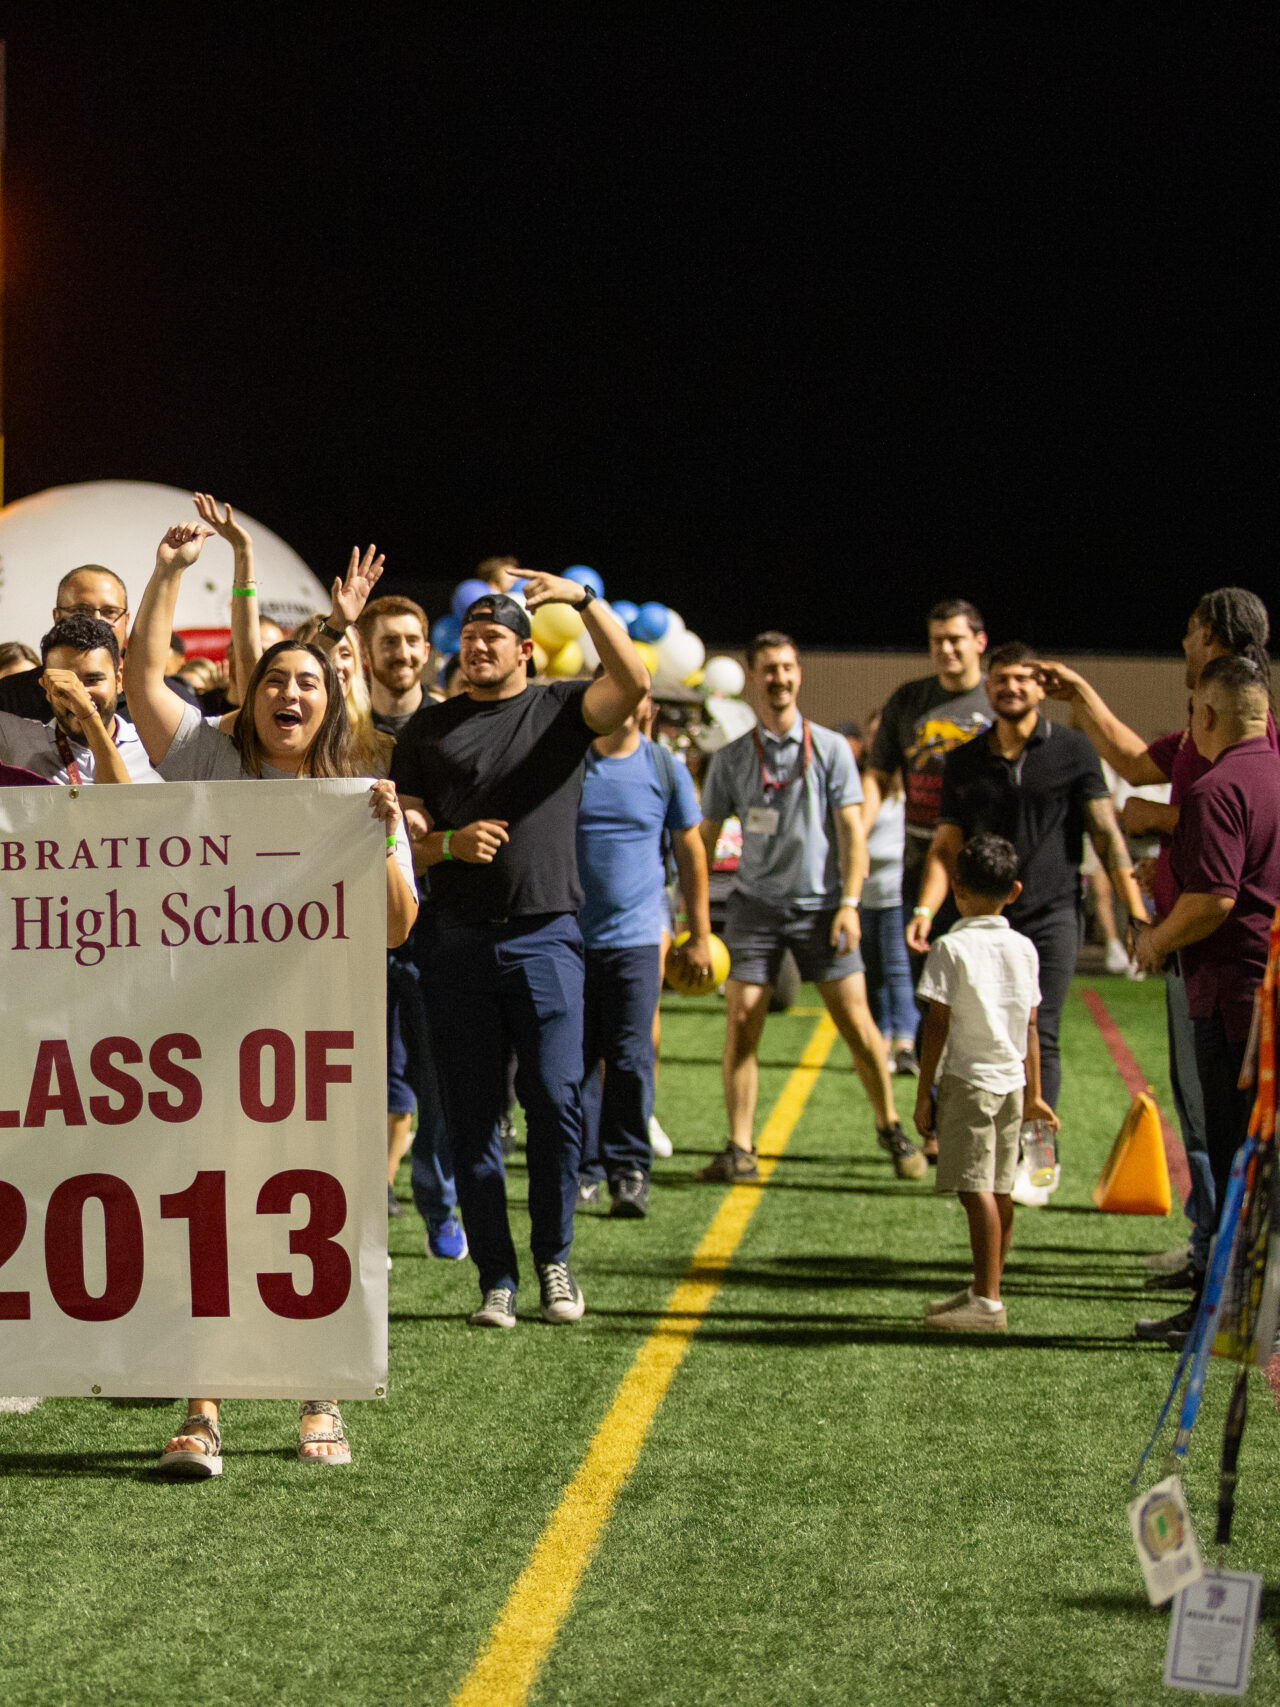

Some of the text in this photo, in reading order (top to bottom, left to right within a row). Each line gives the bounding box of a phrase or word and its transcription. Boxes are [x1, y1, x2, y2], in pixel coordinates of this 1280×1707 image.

[13, 888, 141, 967] High
[161, 880, 351, 947] School
[239, 1028, 355, 1124] OF
